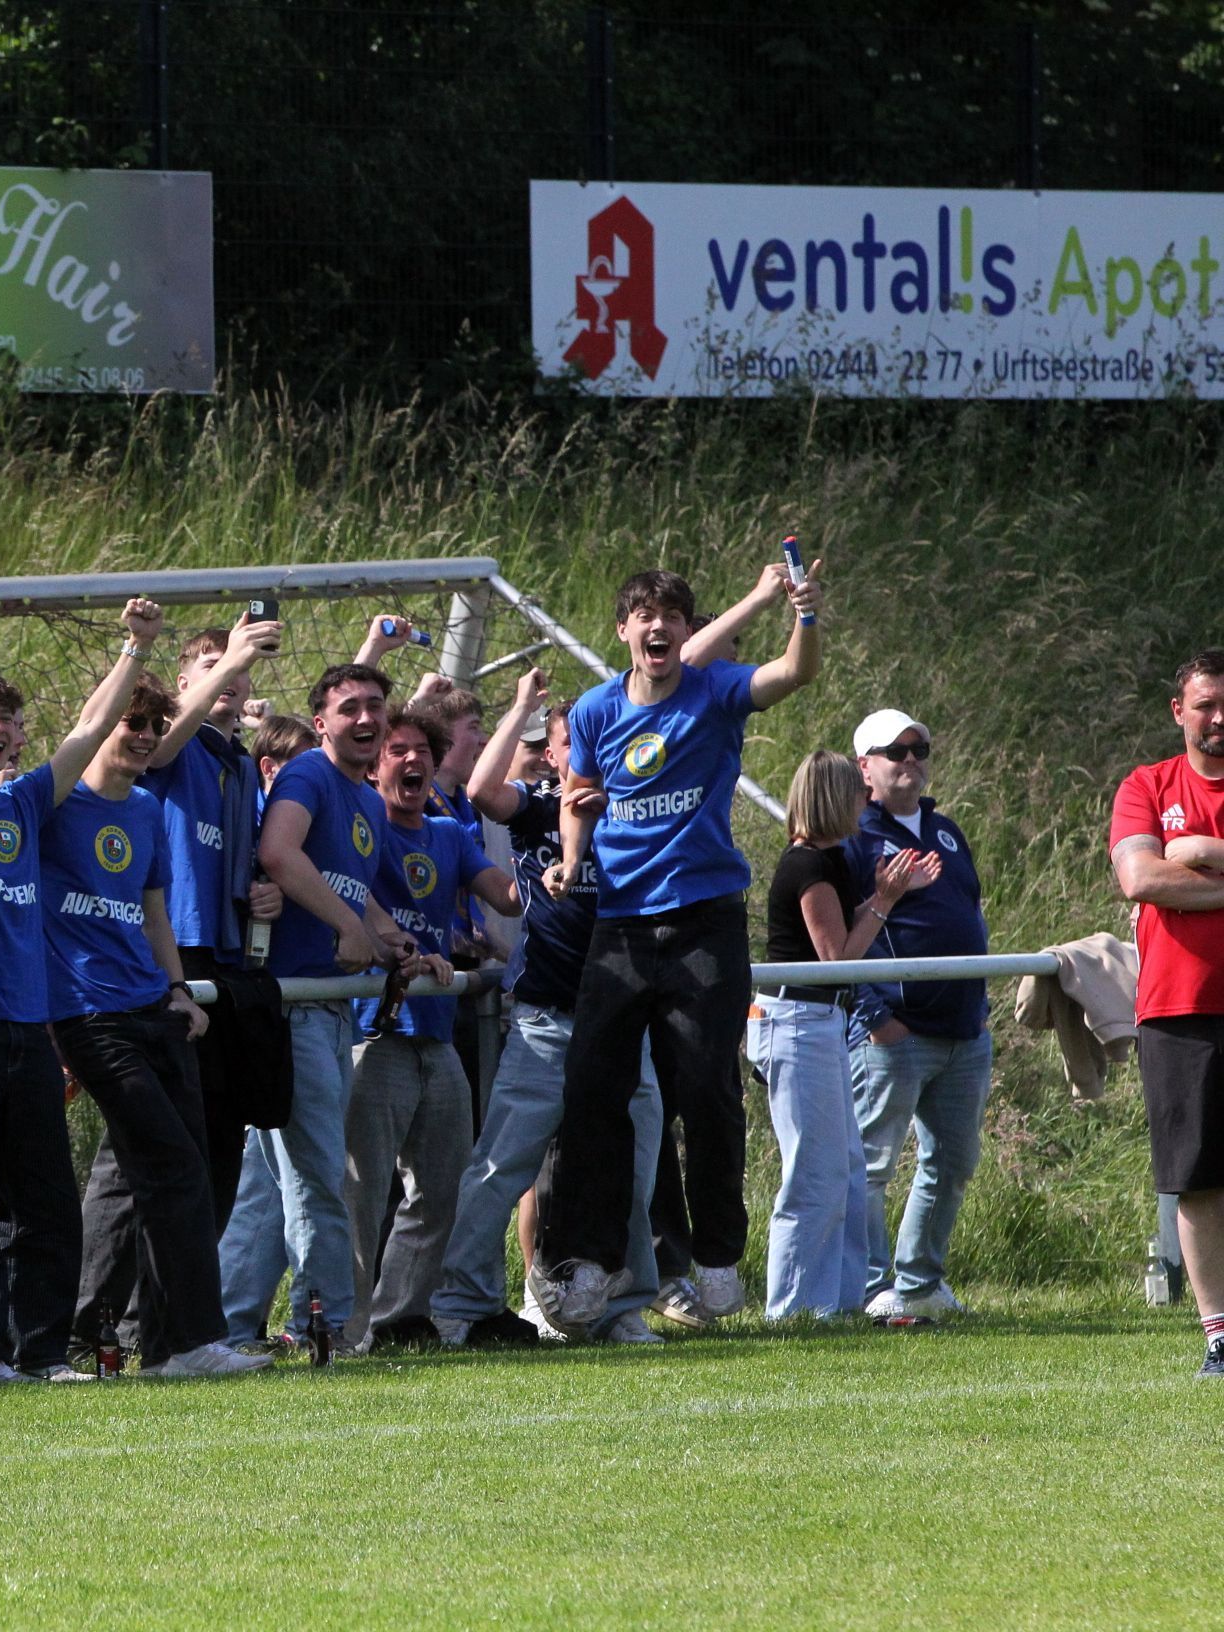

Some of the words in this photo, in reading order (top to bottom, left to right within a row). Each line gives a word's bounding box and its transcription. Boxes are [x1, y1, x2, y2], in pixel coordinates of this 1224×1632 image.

[1047, 225, 1221, 340] Apot
[707, 347, 798, 380] Telefon
[935, 351, 963, 381] 77
[611, 786, 704, 822] AUFSTEIGER
[1160, 816, 1186, 832] TR
